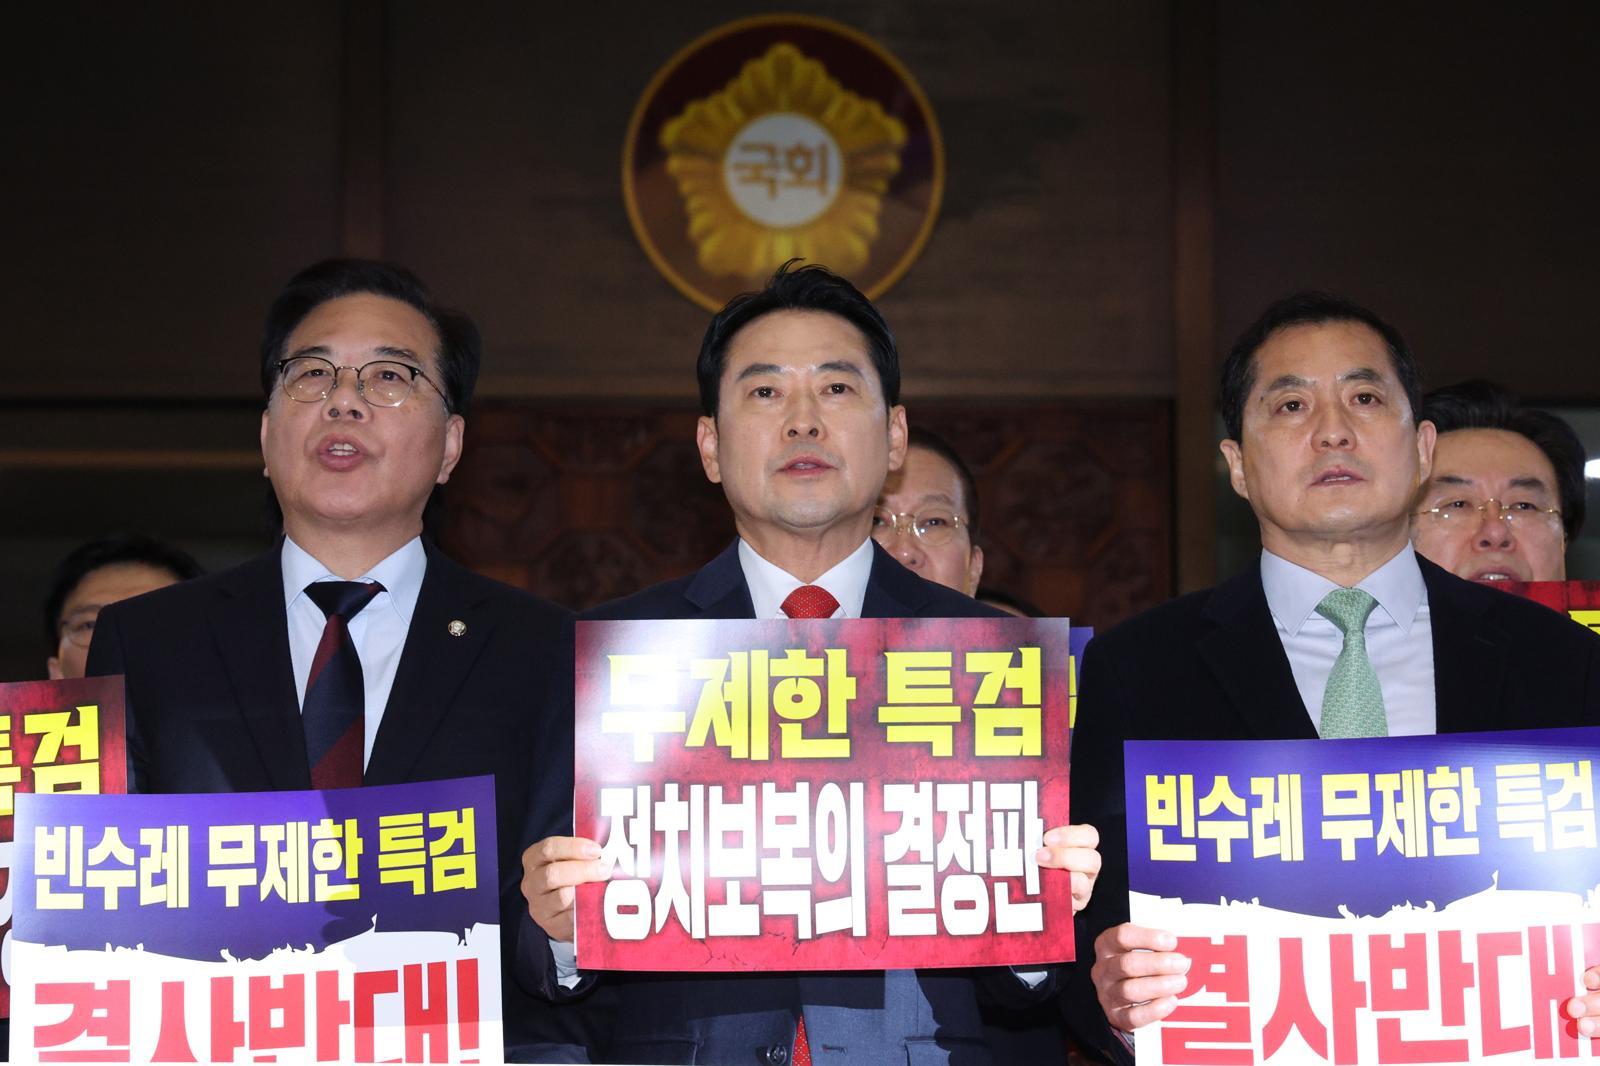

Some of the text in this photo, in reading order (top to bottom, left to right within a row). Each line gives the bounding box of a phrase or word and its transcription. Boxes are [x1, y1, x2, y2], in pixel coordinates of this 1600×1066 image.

[732, 142, 828, 200] 국회
[601, 648, 857, 762] 무제한
[877, 647, 1042, 758] 특검
[0, 705, 99, 815] 검
[1145, 760, 1598, 863] 빈수레 무제한 특검
[33, 807, 477, 911] 빈수레 무제한 특검
[600, 780, 1044, 939] 정치보복의 결정판
